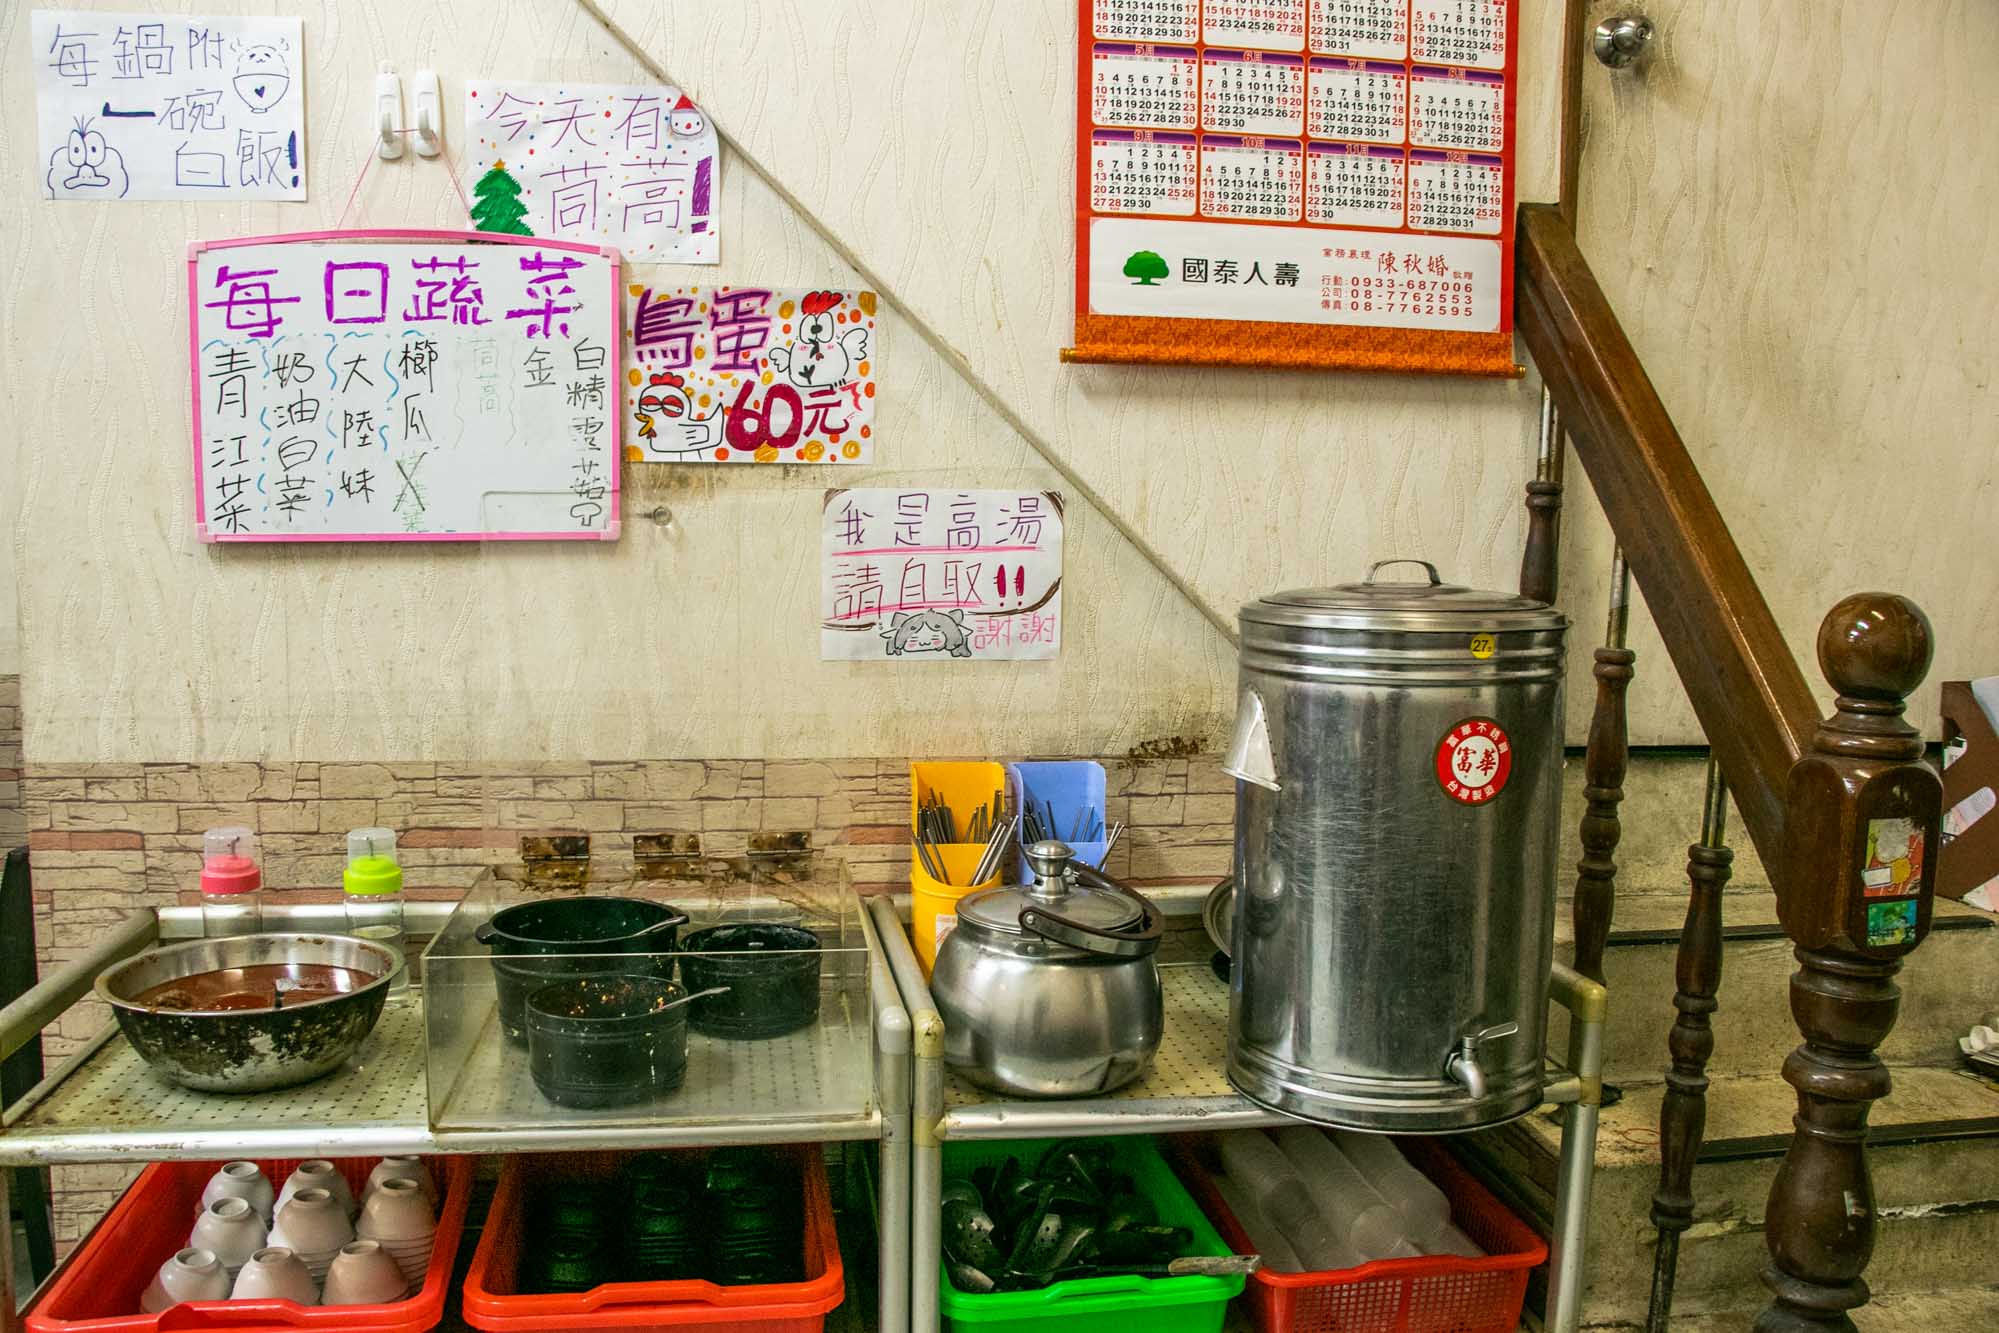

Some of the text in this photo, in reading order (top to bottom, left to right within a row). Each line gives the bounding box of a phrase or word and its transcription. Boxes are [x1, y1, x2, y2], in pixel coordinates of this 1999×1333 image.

[1095, 11, 1197, 25] 18 19 20 21 22 23 24
[1204, 17, 1302, 33] 22 23 24 25 26 27 28
[1310, 25, 1405, 42] 22 23 24 25 26 27 28
[1413, 22, 1506, 40] 12 13 14 15 16 17 18
[48, 24, 224, 86] 每鍋附
[1097, 72, 1192, 86] 3 4 5 6 7 8 9
[1094, 85, 1196, 99] 10 11 12 13 14 15 16
[1203, 91, 1301, 106] 14 15 16 17 18 19 20
[1312, 86, 1405, 101] 5 6 7 8 9 10 11
[102, 89, 225, 133] 一碗
[1309, 98, 1405, 114] 12 13 14 15 16 17 18
[1413, 106, 1503, 123] 9 10 11 12 13 14 15
[486, 92, 660, 150] 今天有
[1096, 159, 1196, 172] 6 7 8 9 10 11 12
[1325, 159, 1331, 168] 2
[1339, 160, 1345, 169] 3
[1352, 161, 1359, 169] 4
[1366, 162, 1372, 171] 5
[1380, 163, 1386, 172] 6
[1393, 164, 1399, 172] 7
[1093, 172, 1196, 185] 13 14 15 16 17 18 19
[1202, 177, 1302, 191] 11 12 13 14 15 16 17
[1308, 183, 1403, 198] 15 16 17 18 19 20 21
[1410, 190, 1502, 206] 13 14 15 16 17 18 19
[1182, 257, 1300, 287] 國泰人壽
[205, 251, 587, 338] 每日蔬菜
[725, 379, 849, 451] 60元
[272, 351, 319, 521] 奶油白菜
[340, 354, 375, 503] 大陸妹
[208, 348, 256, 531] 青江菜
[834, 493, 1047, 550] 我是高湯
[974, 614, 1056, 650] 謝謝
[1456, 746, 1496, 777] 富華
